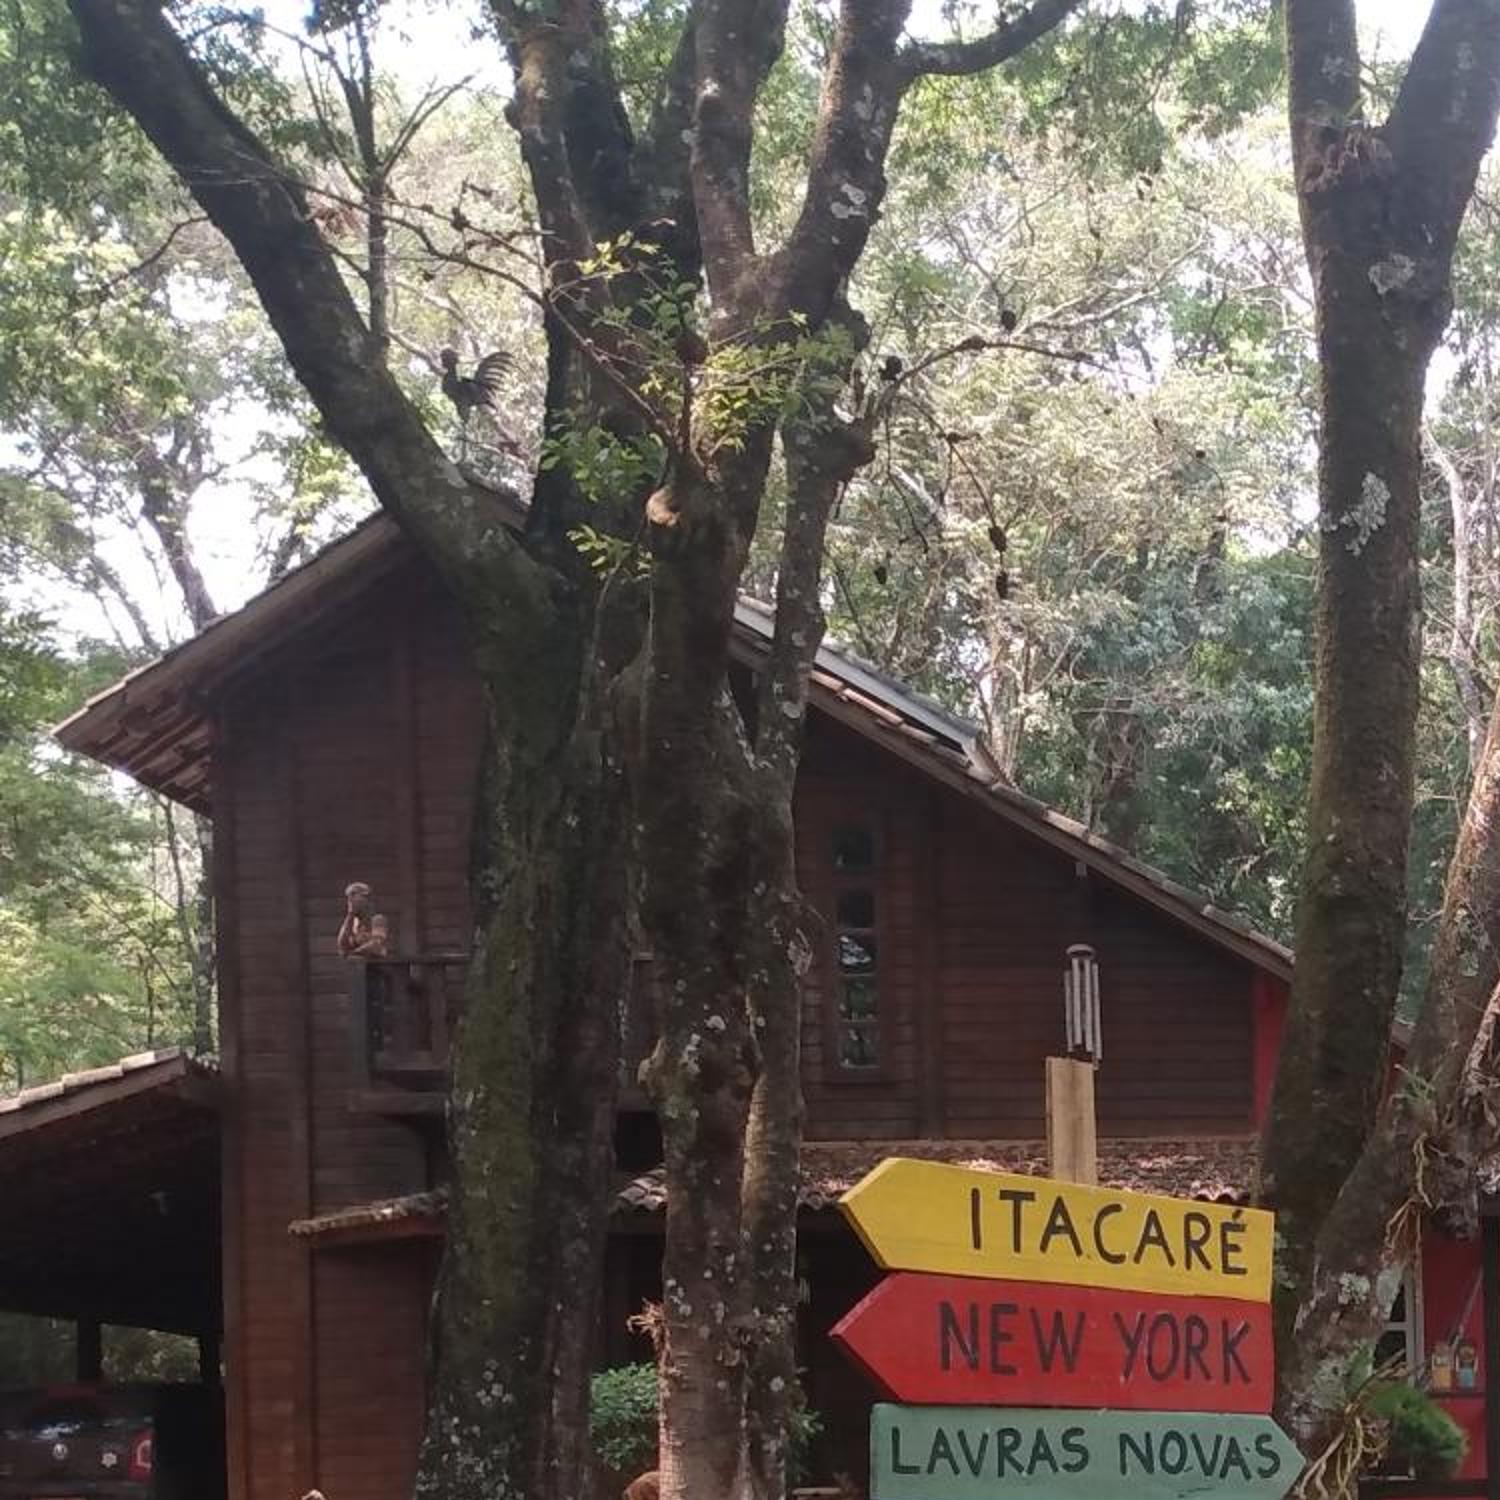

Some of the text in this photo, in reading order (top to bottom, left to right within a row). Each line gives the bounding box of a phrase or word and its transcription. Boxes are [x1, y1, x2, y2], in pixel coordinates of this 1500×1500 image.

[970, 1187, 1248, 1275] ITACARÉ
[938, 1302, 1251, 1385] NEW YORK
[891, 1427, 1281, 1481] LAVRAS NOVAS
